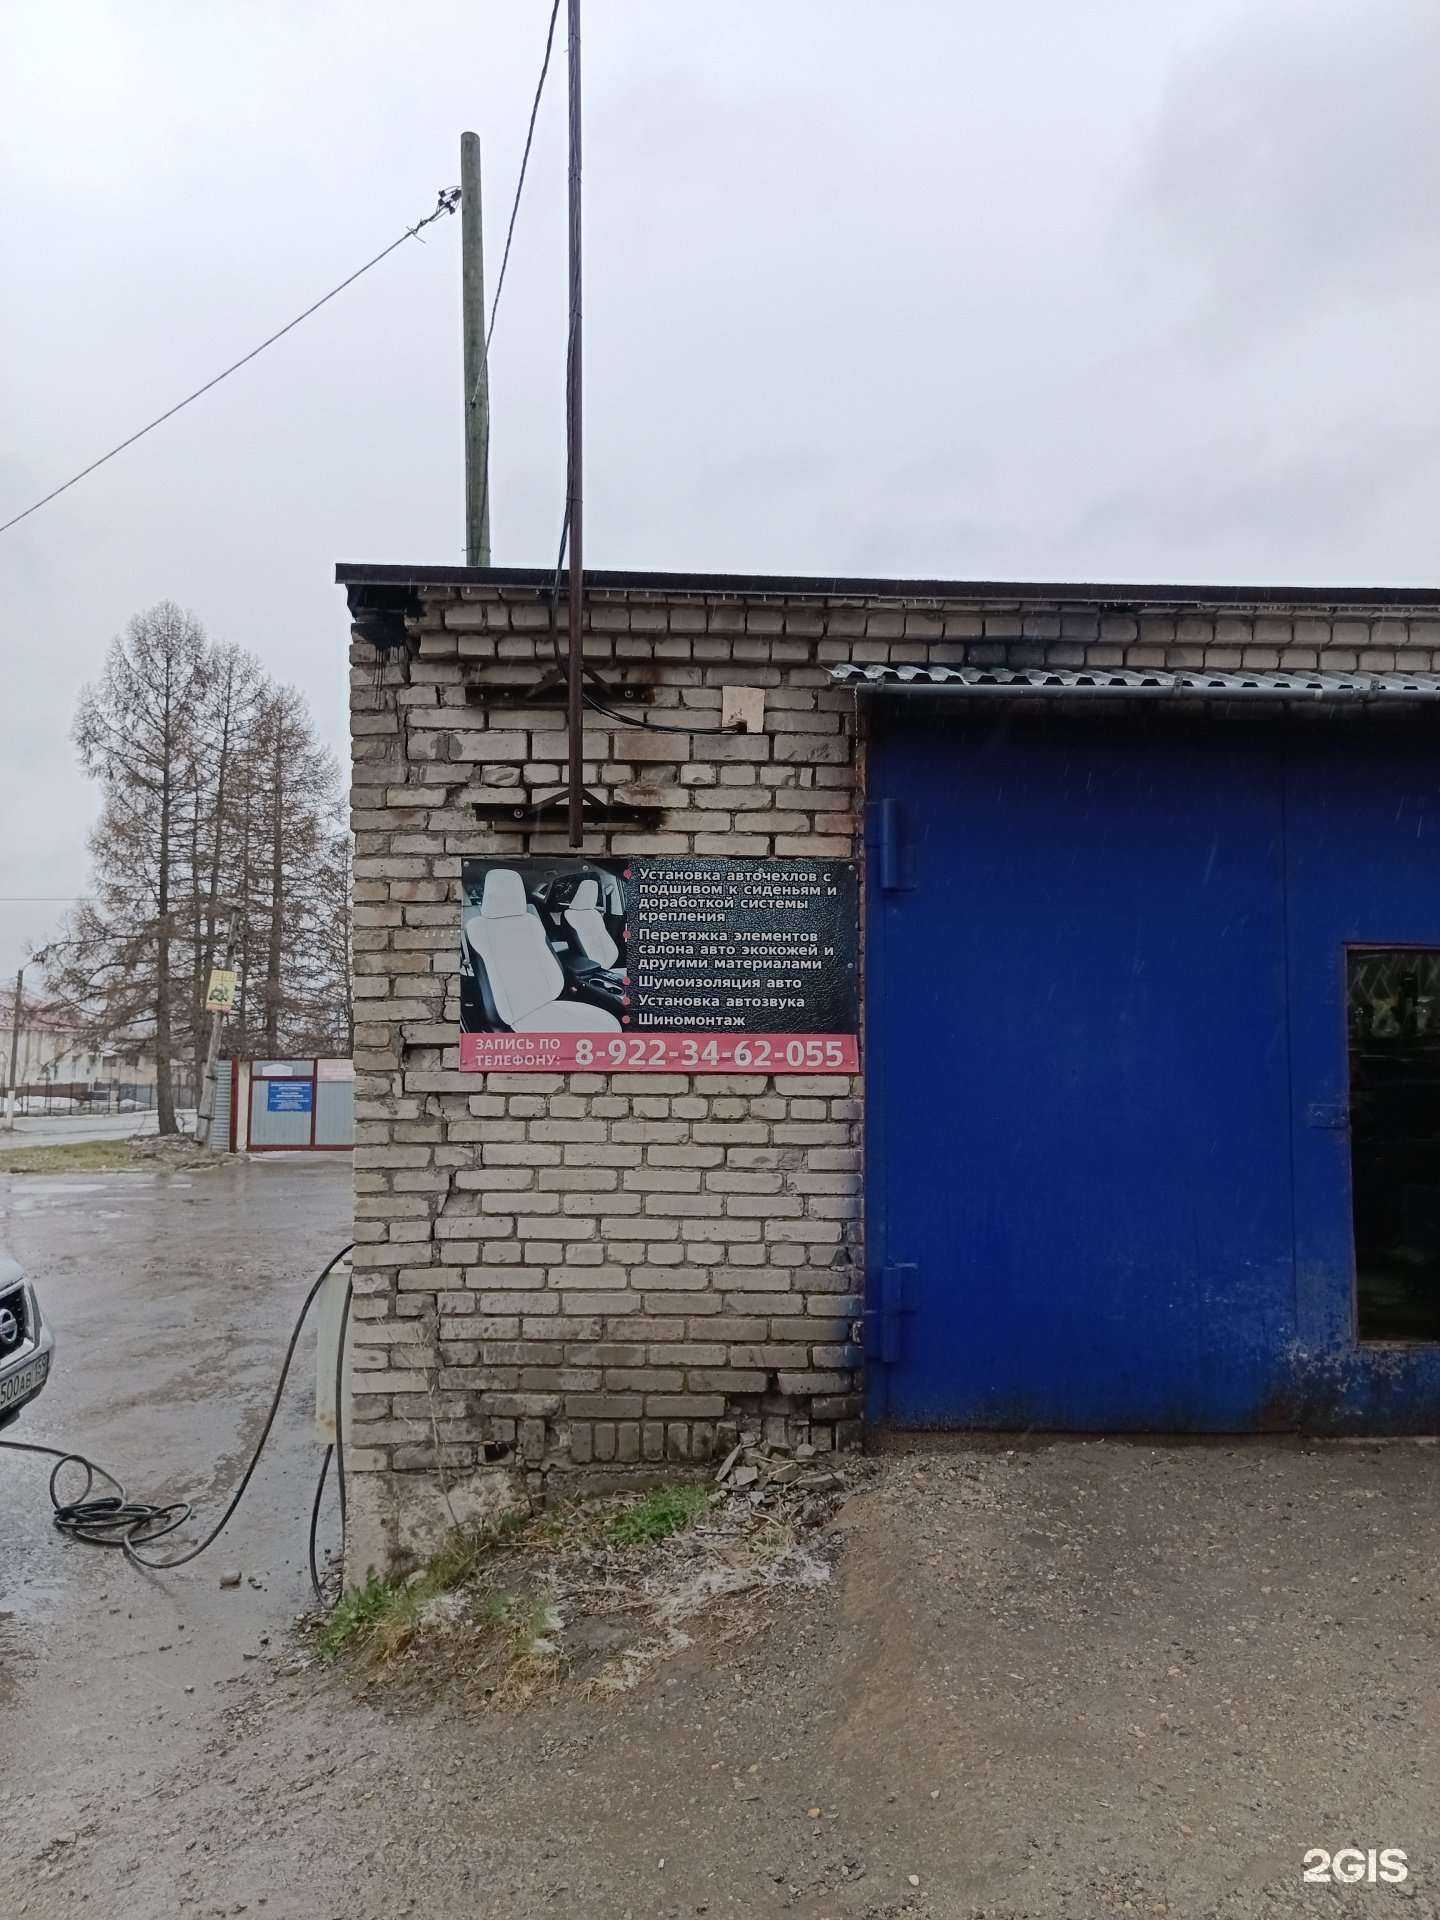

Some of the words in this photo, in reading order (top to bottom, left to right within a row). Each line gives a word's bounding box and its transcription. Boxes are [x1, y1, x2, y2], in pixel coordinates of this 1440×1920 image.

[639, 868, 720, 882] Установка
[728, 871, 817, 882] авточехлов
[823, 873, 831, 882] с
[639, 884, 722, 896] подшивом
[729, 885, 737, 894] к
[744, 885, 820, 897] сиденьям
[828, 886, 837, 895] и
[638, 896, 734, 910] доработкой
[740, 899, 808, 909] системы
[639, 911, 726, 923] крепления
[639, 929, 728, 943] Перетяжка
[734, 932, 818, 942] элементов
[638, 945, 694, 955] салона
[700, 946, 736, 955] авто
[742, 944, 818, 956] экокожей
[824, 947, 834, 956] и
[638, 959, 708, 970] другими
[714, 960, 822, 971] материалами
[638, 976, 761, 990] Шумоизоляция
[767, 979, 802, 989] авто
[638, 994, 720, 1007] Установка
[726, 997, 805, 1009] автозвука
[638, 1014, 746, 1026] Шиномонтаж
[475, 1038, 535, 1051] ЗАПИСЬ
[538, 1038, 561, 1050] ПО
[475, 1054, 561, 1066] ТЕЛЕФОНУ:
[575, 1040, 844, 1067] 8-922-34-62-055
